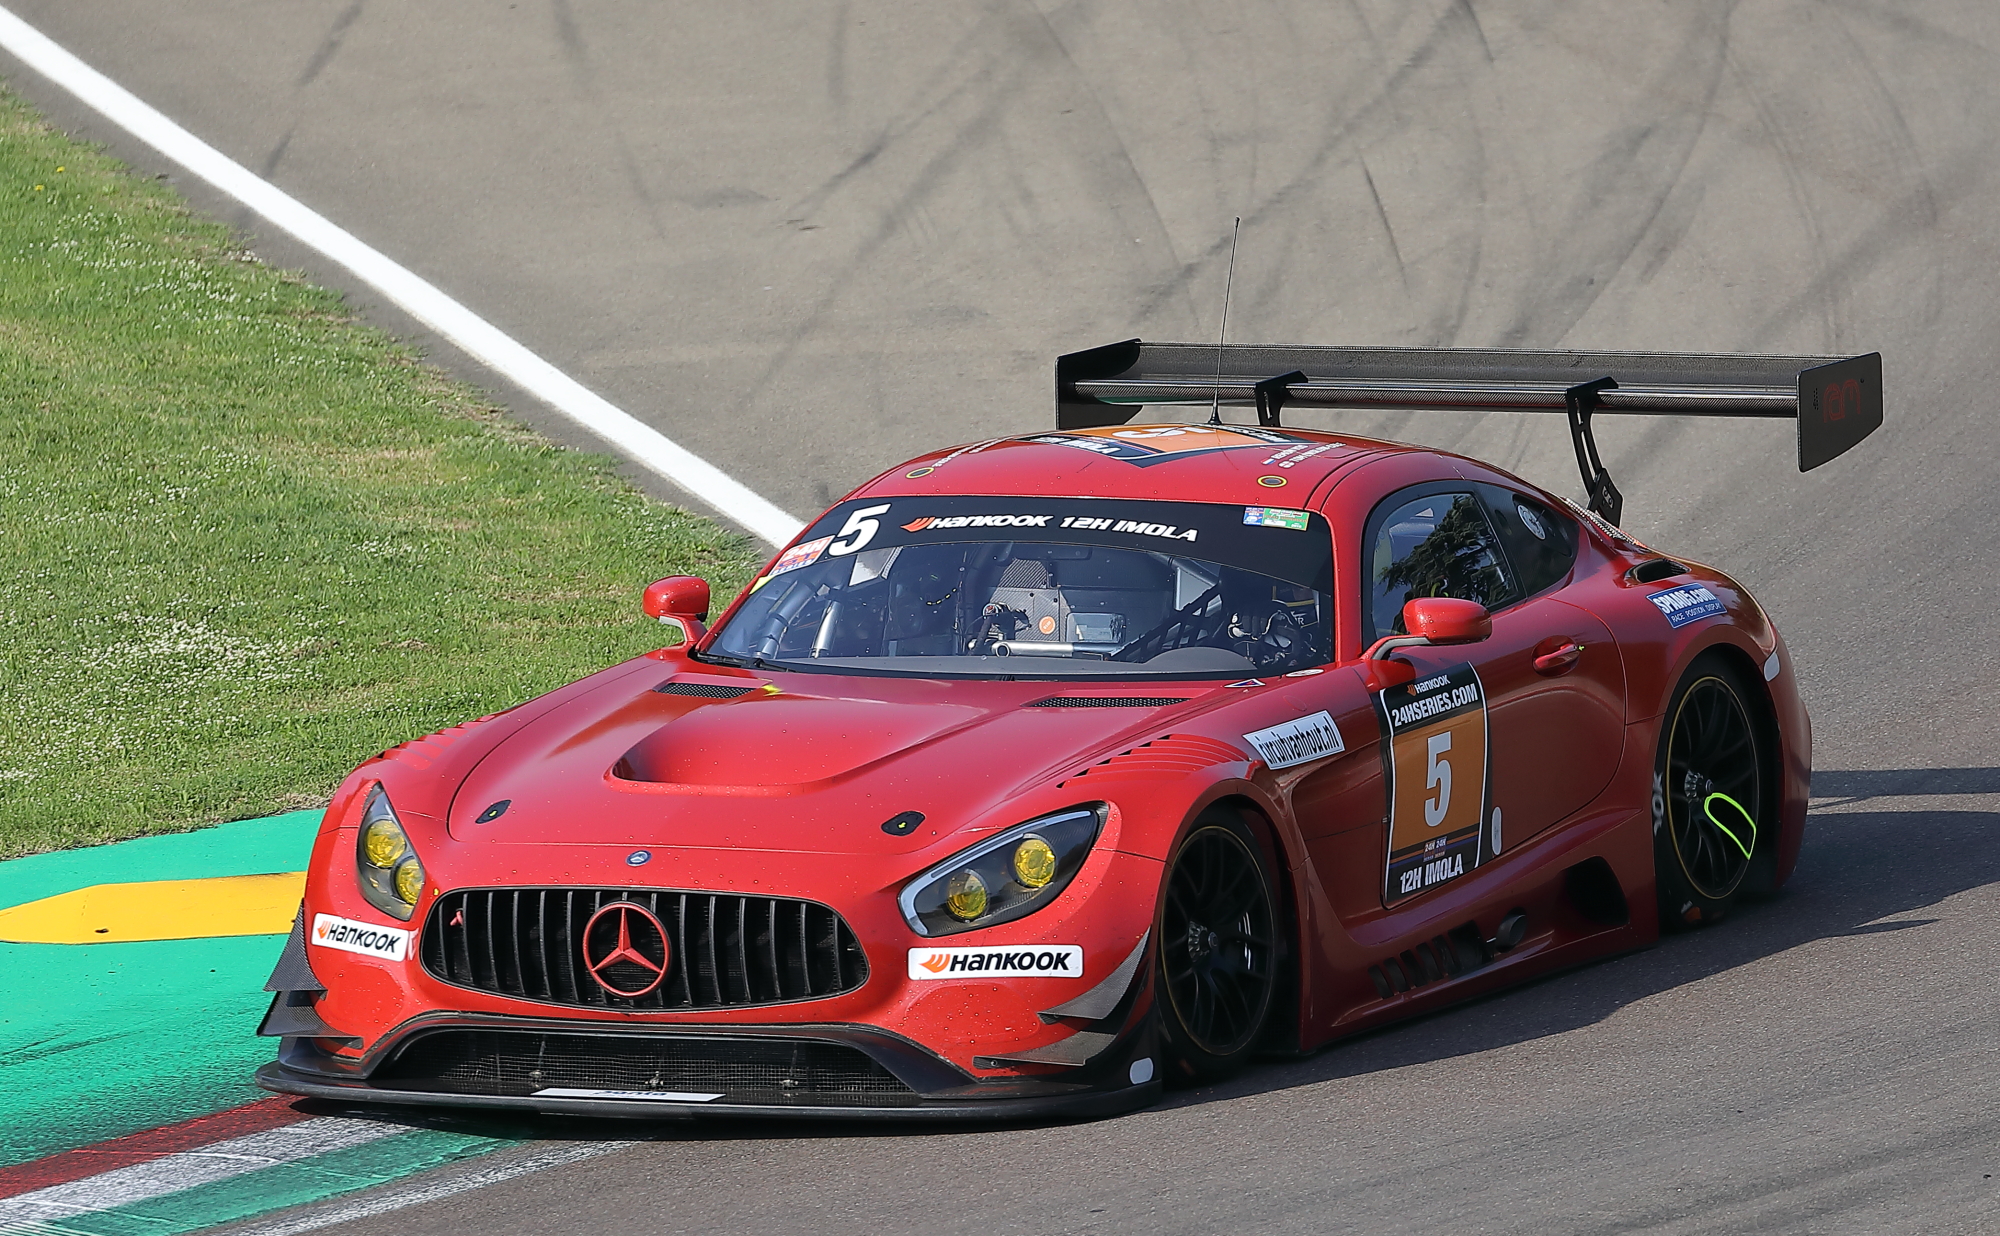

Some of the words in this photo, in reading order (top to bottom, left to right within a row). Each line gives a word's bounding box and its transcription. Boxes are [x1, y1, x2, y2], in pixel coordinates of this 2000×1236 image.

[829, 504, 892, 556] 5
[1060, 516, 1113, 531] 12H
[1112, 519, 1198, 541] IMOLA
[1391, 683, 1479, 727] 24HSERIES.COM
[1255, 716, 1340, 765] circuitvanhout.nl
[1424, 731, 1452, 827] 5
[1400, 866, 1422, 893] 12H
[1425, 853, 1464, 886] IMOLA
